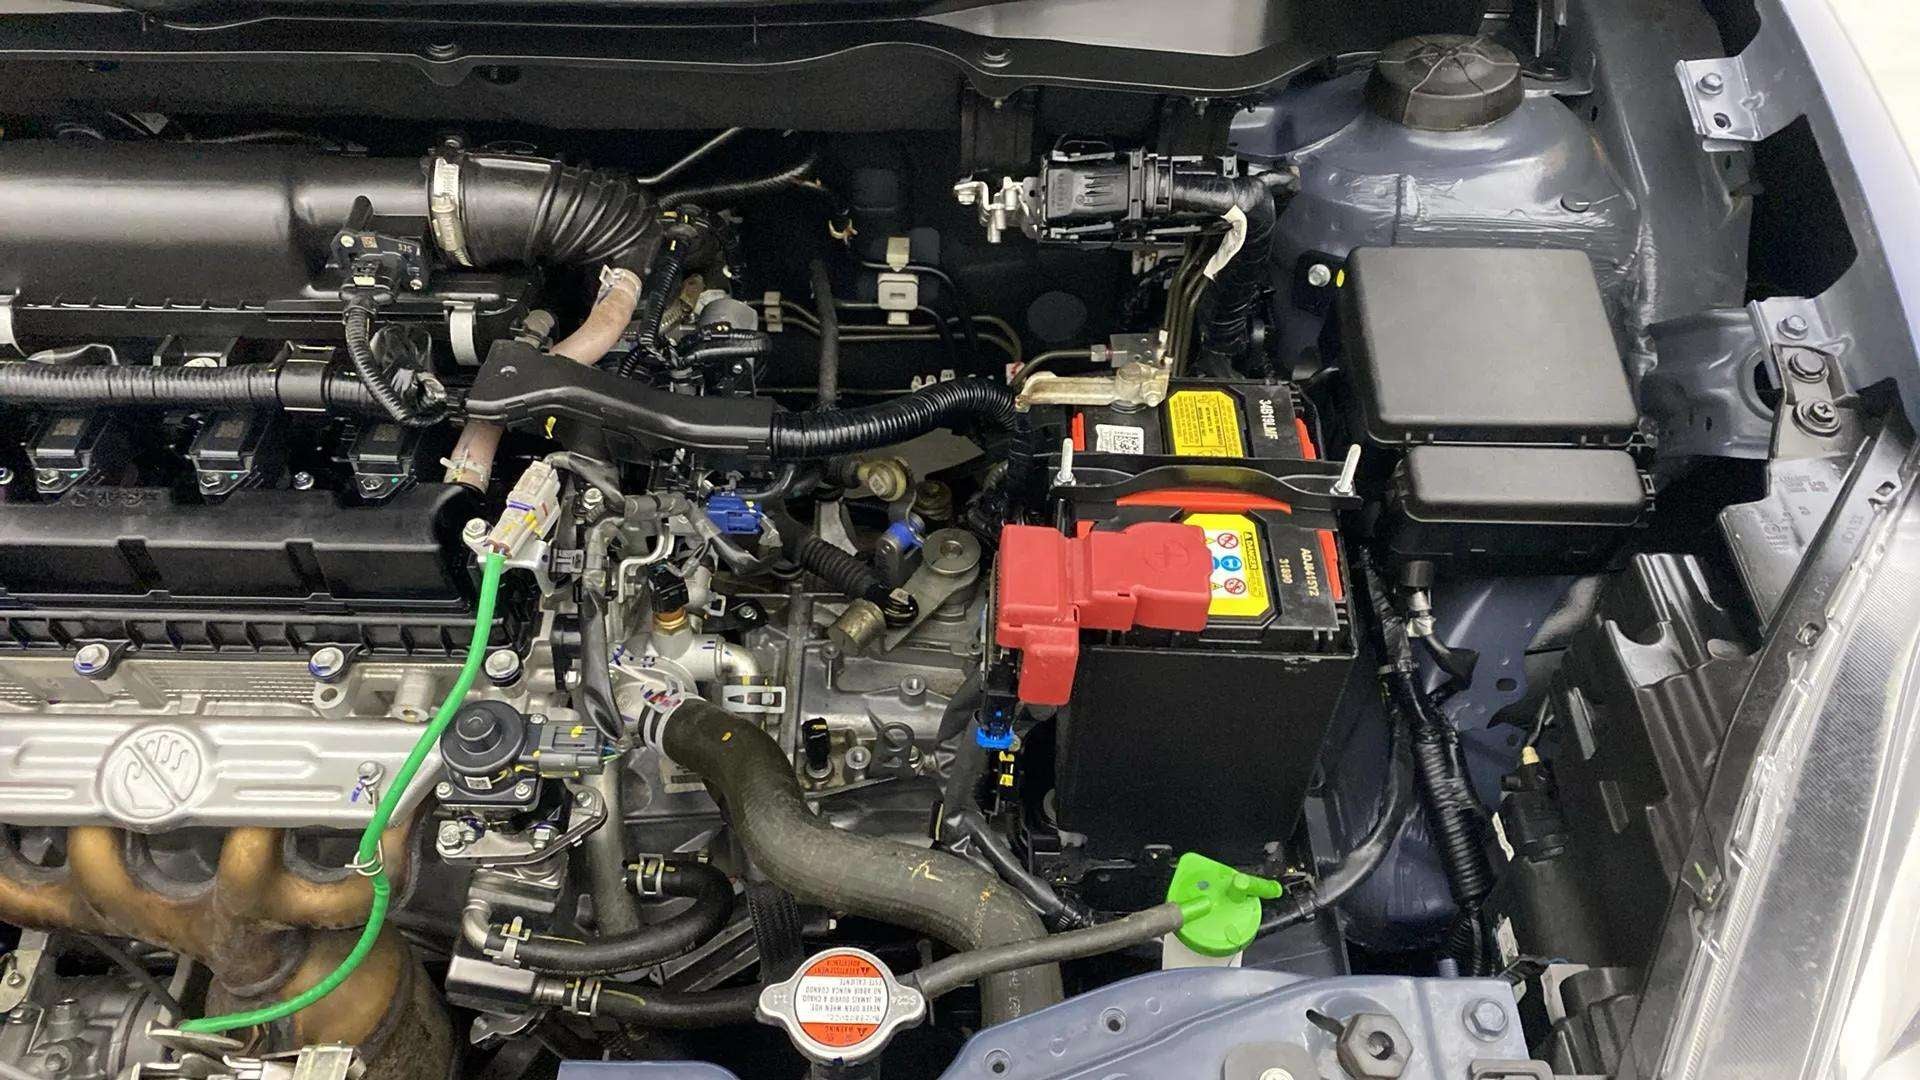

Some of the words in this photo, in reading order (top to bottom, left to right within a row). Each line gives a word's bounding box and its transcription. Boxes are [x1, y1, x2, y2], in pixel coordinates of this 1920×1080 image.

[1259, 399, 1278, 440] 34B19LMF
[1246, 540, 1258, 571] DANGER
[845, 1004, 860, 1012] OPEN
[861, 1004, 880, 1012] NEVER
